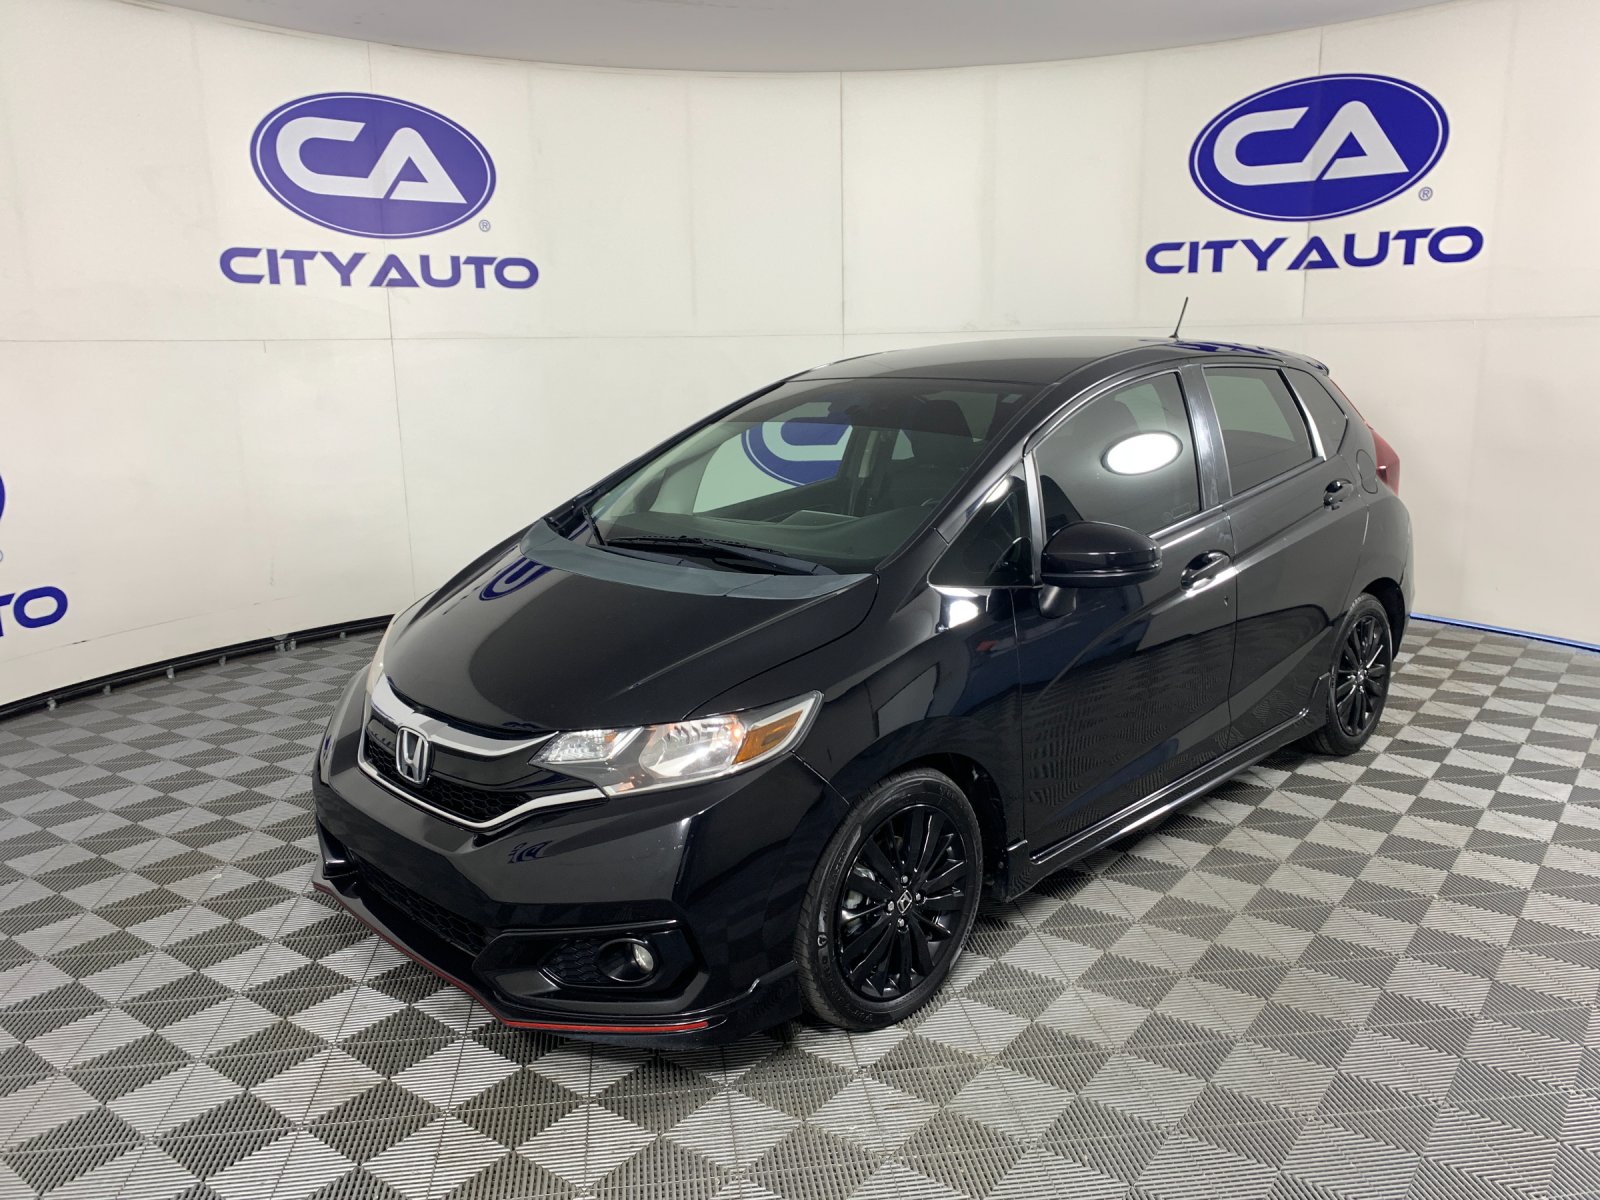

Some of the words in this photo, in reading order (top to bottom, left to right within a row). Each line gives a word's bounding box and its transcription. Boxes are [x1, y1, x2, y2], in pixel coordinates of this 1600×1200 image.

[275, 116, 468, 204] CA
[1213, 100, 1410, 187] CA
[219, 246, 368, 287] CITY
[369, 252, 539, 289] AUTO
[1145, 236, 1289, 274] CITY
[1286, 225, 1484, 271] AUTO
